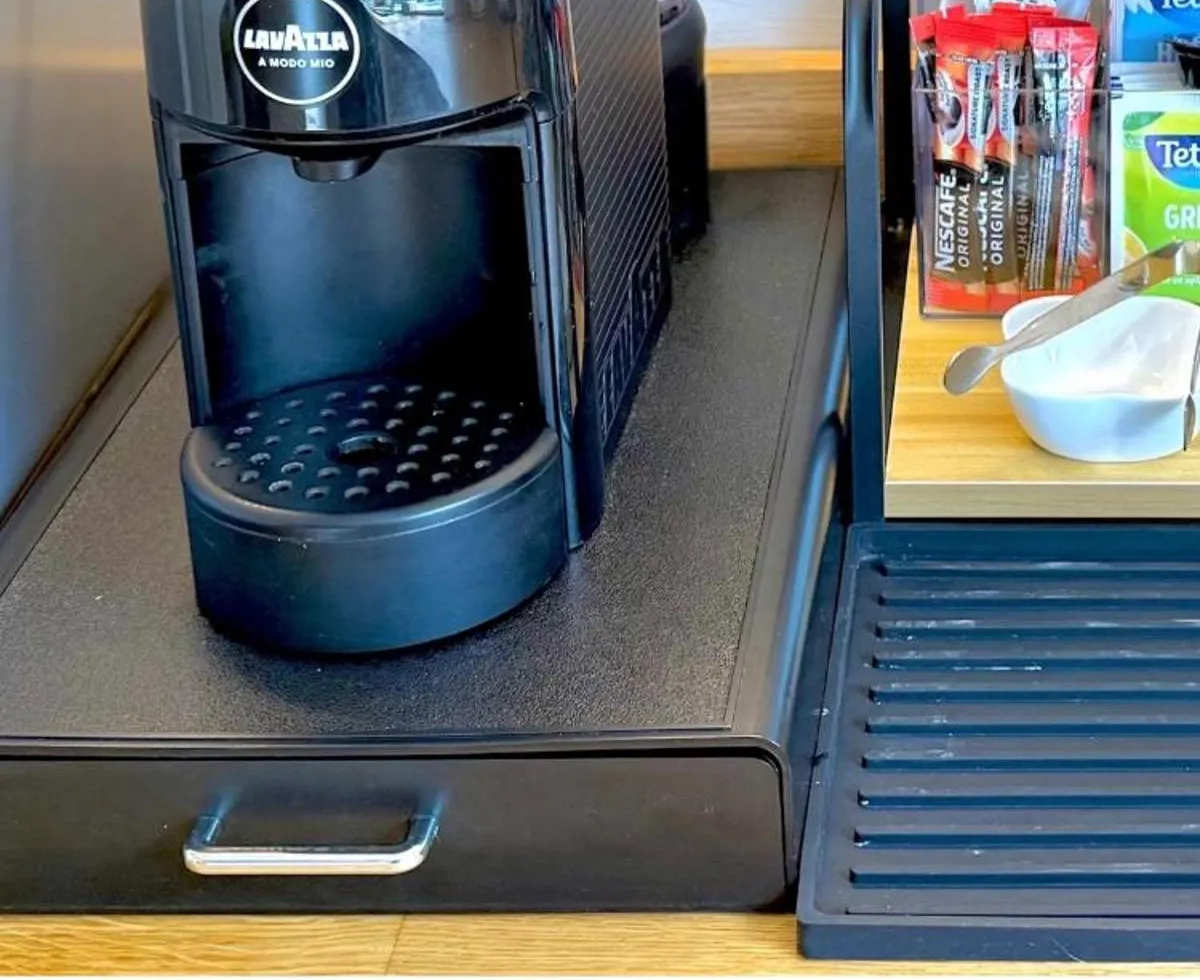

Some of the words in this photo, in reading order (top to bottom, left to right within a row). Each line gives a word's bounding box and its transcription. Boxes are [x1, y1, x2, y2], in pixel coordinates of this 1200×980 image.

[242, 23, 350, 52] LAVAZZA
[257, 56, 268, 68] A
[269, 57, 307, 69] MODO
[309, 58, 336, 69] MIO
[956, 183, 971, 268] ORIGINAL
[989, 175, 1005, 266] ORIGINAL
